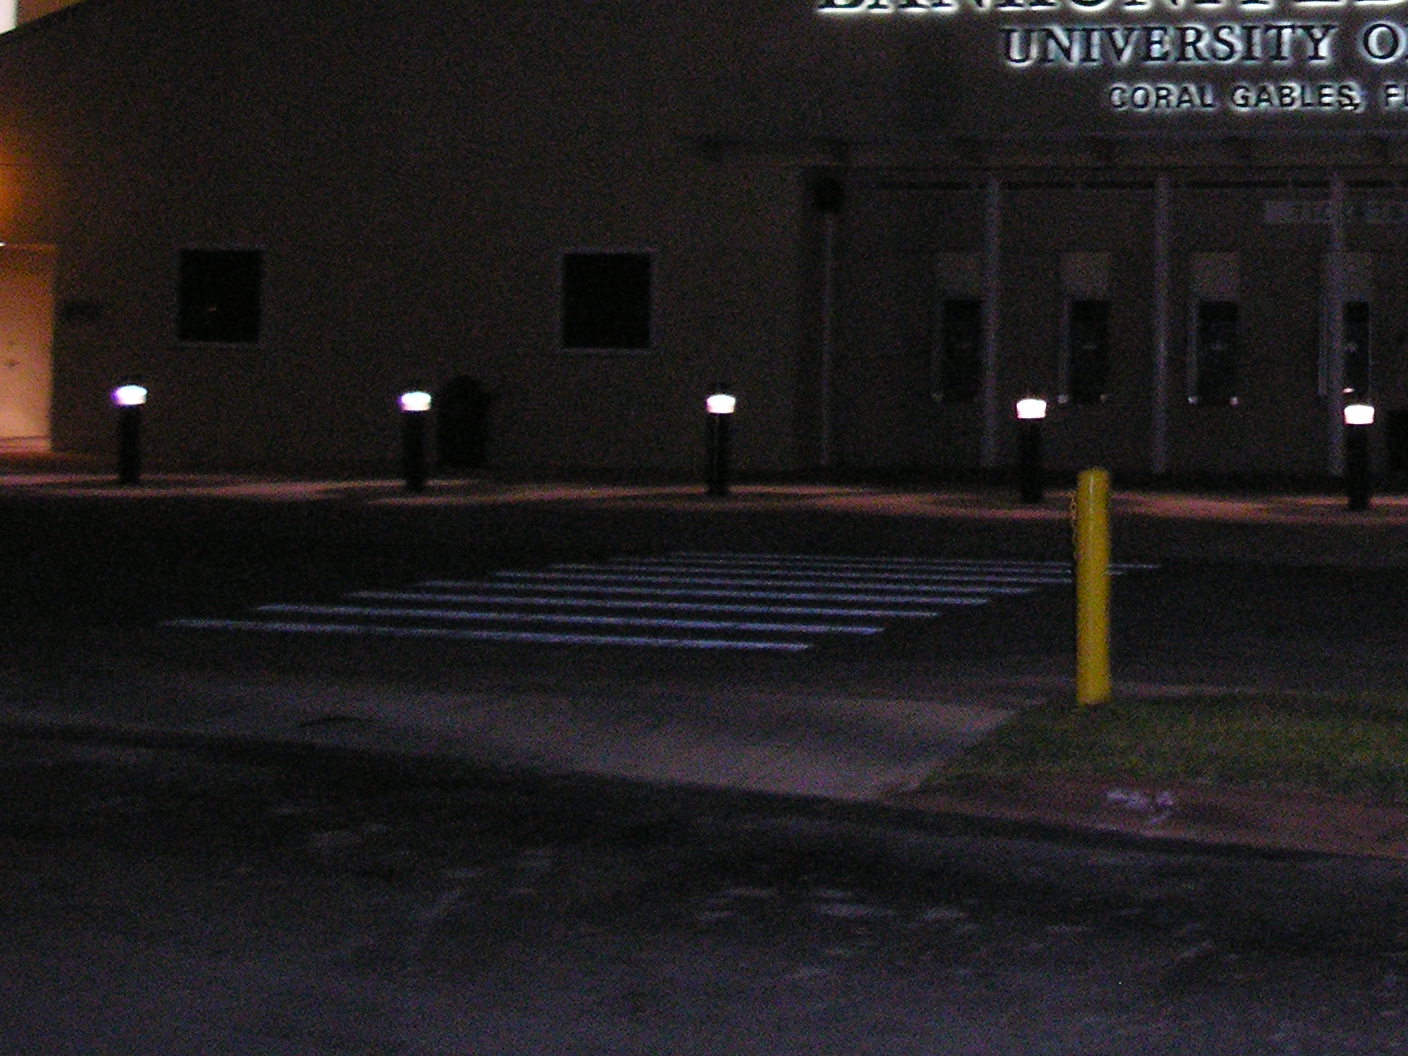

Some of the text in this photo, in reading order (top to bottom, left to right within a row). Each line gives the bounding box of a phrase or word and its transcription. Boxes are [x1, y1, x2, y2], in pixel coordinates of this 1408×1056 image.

[1000, 23, 1338, 64] UNIVERSITY
[1109, 84, 1218, 110] CORAL
[1230, 84, 1362, 112] GABLES,
